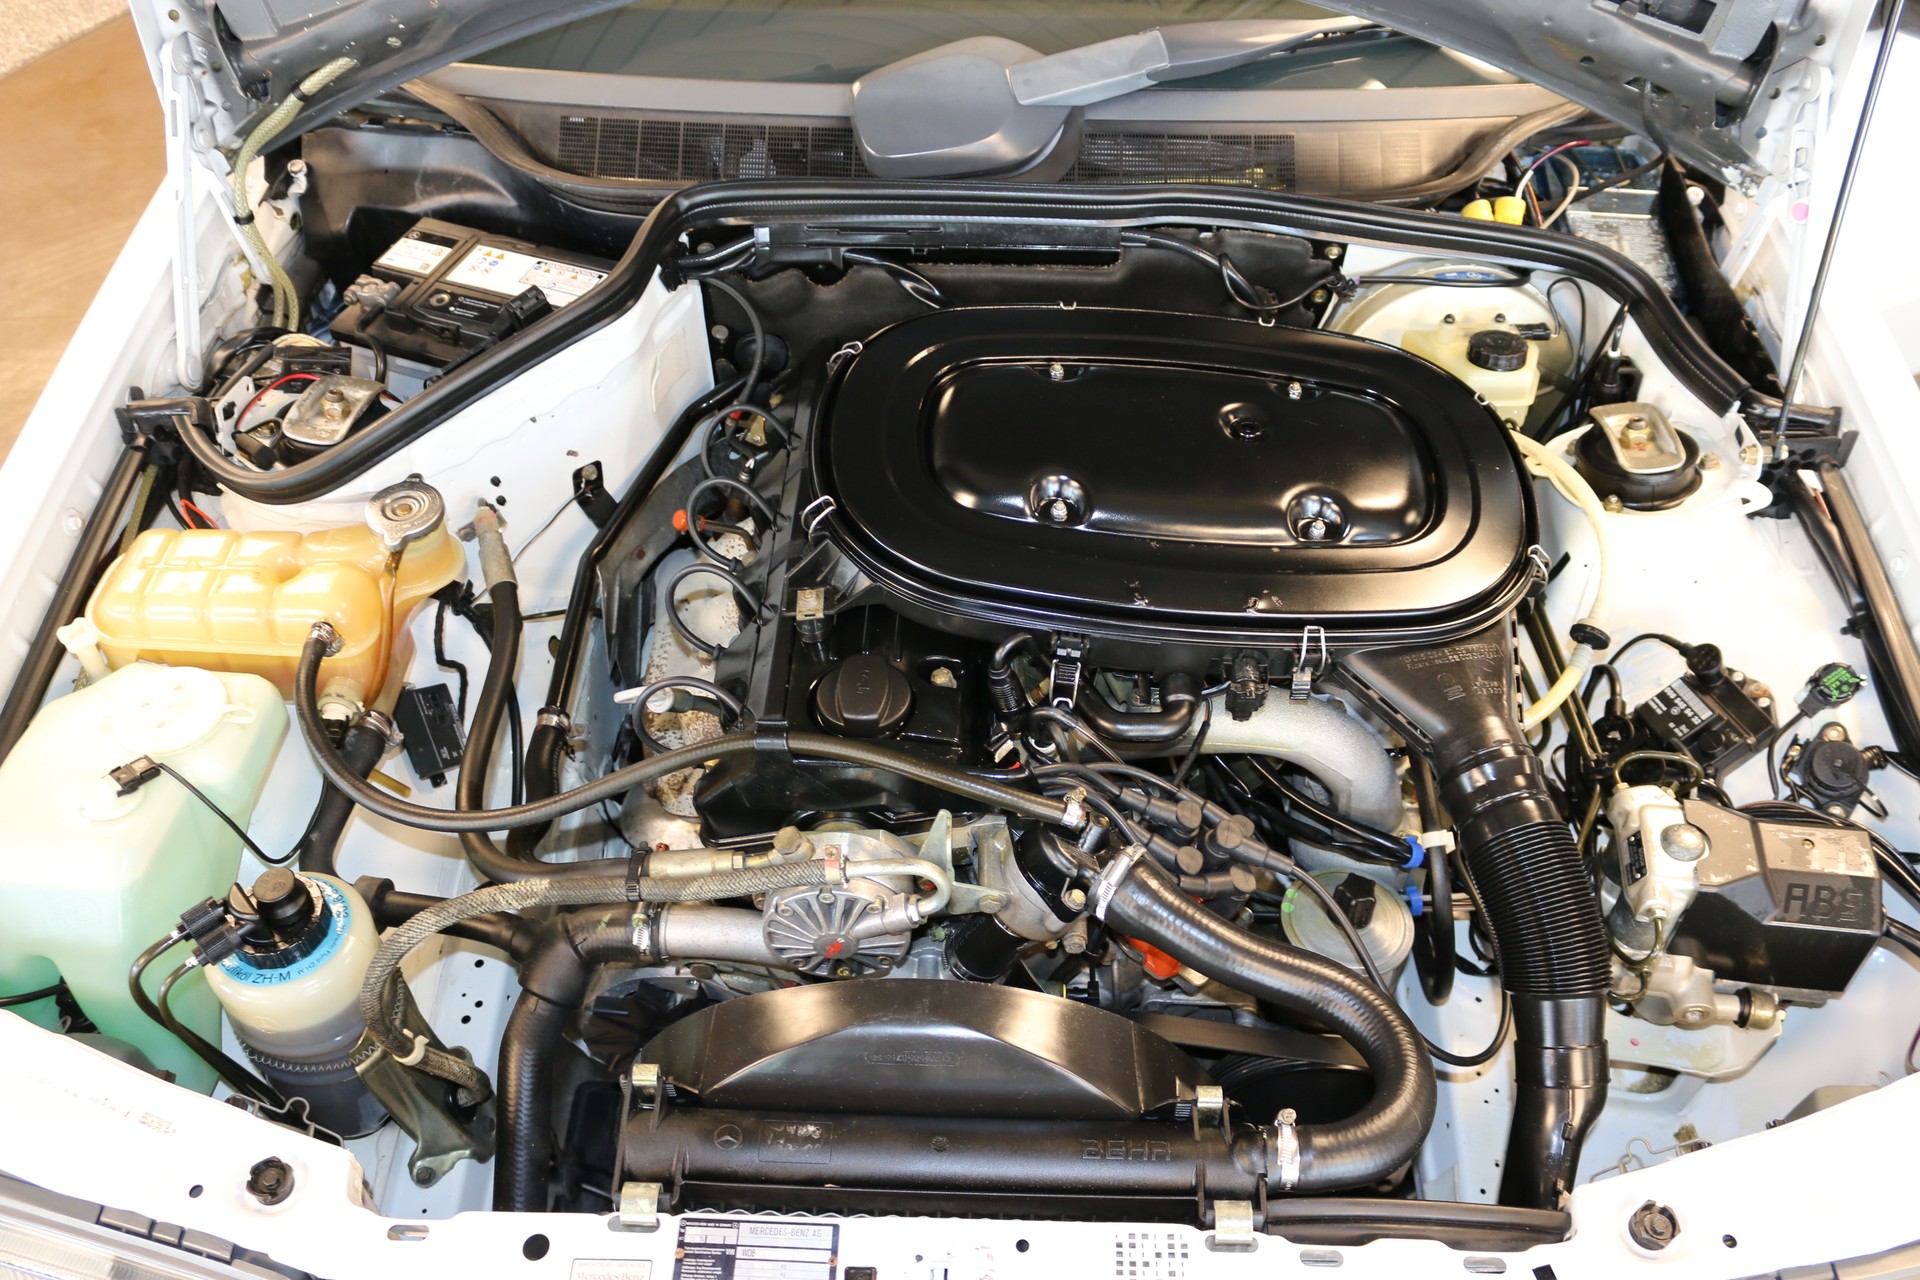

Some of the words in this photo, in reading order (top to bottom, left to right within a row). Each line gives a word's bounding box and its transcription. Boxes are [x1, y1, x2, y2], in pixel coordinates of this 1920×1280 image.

[1783, 882, 1864, 921] ABS
[252, 971, 291, 984] ZH-M
[1080, 1139, 1171, 1160] BEHR
[749, 1226, 810, 1238] MERCEDES-BENZ
[812, 1228, 822, 1238] AG
